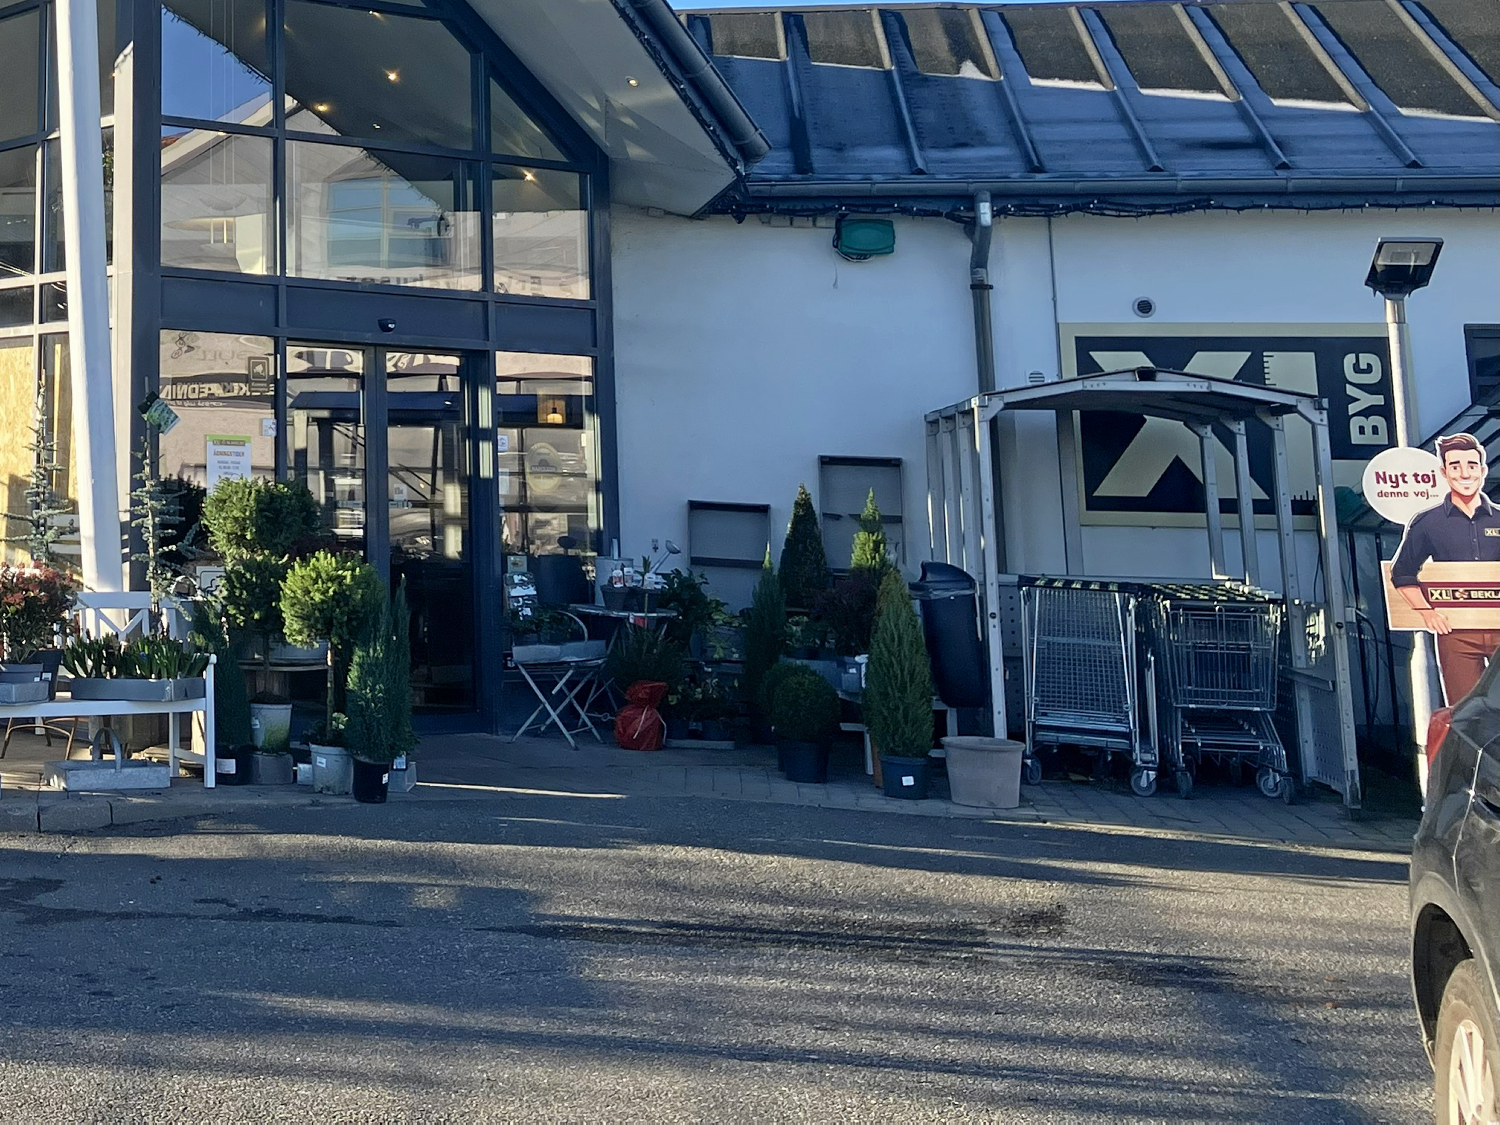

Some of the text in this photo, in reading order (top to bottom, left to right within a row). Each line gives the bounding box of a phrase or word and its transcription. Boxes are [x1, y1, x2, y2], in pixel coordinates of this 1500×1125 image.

[1343, 353, 1389, 445] BYG
[1375, 470, 1437, 488] Nyt tøj
[1377, 490, 1409, 498] denne
[1430, 589, 1451, 600] XL
